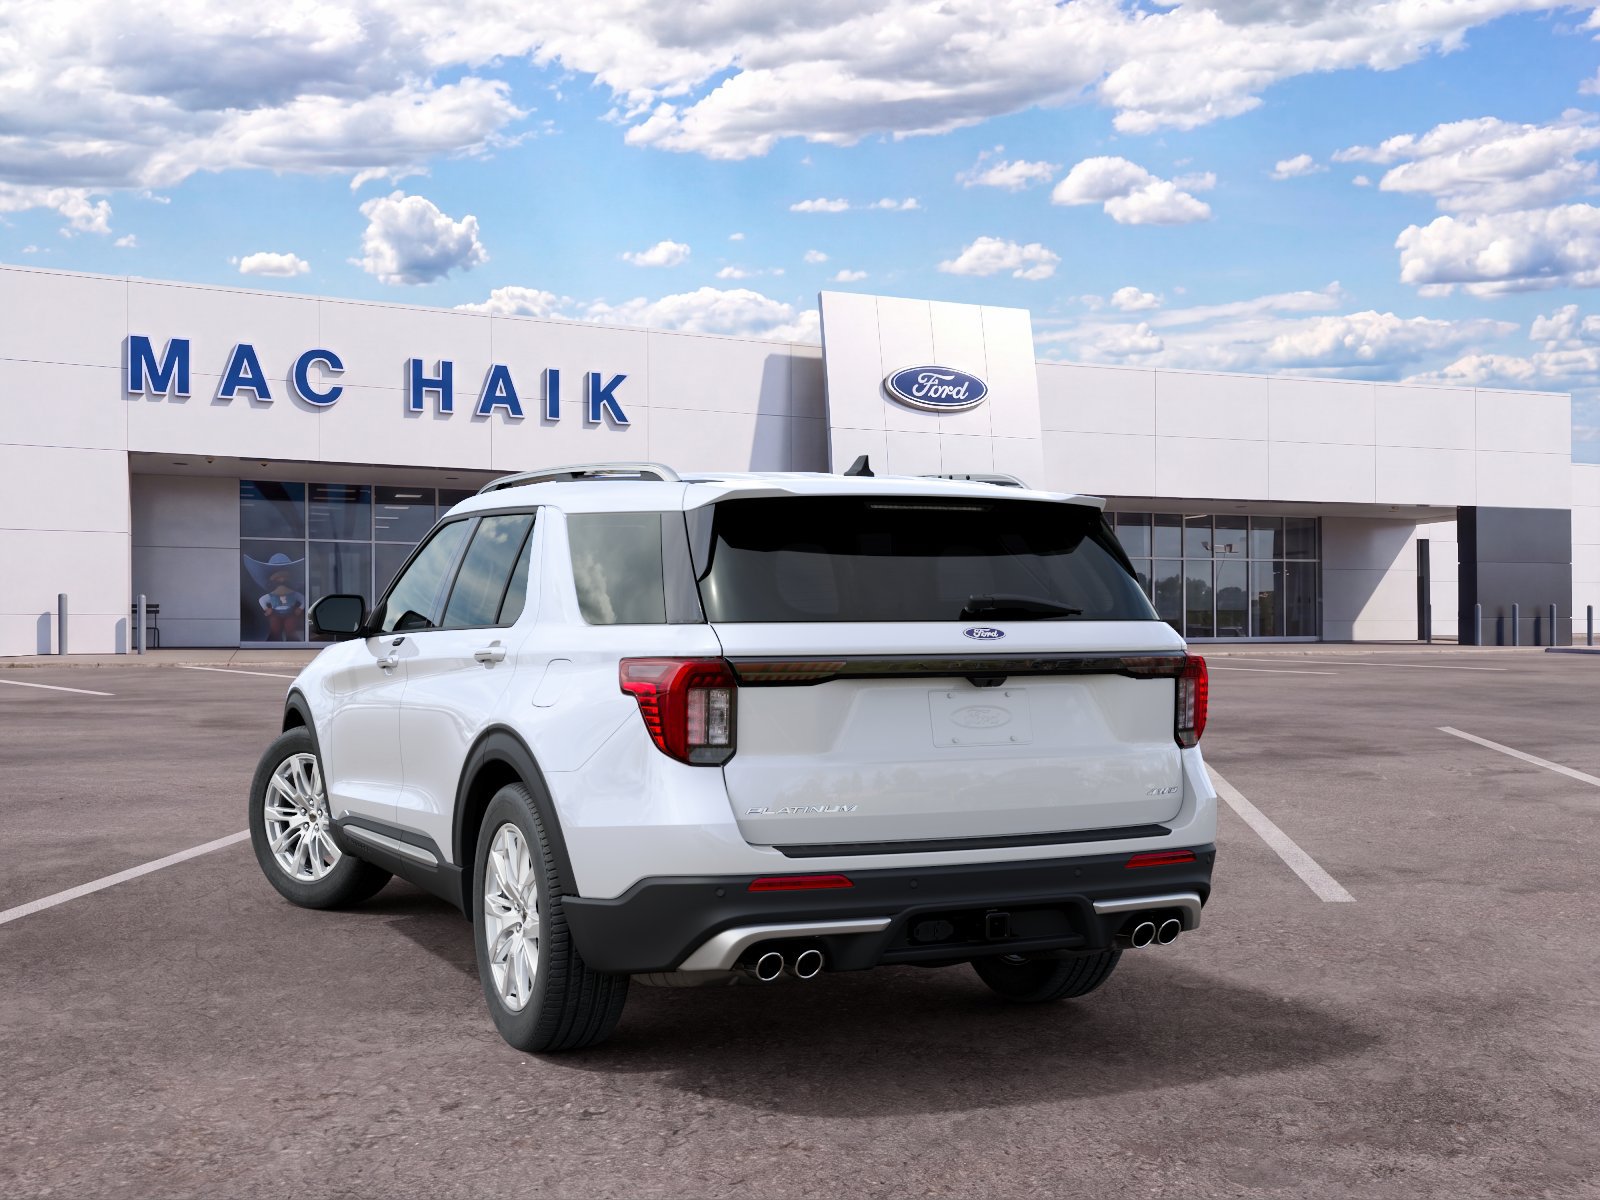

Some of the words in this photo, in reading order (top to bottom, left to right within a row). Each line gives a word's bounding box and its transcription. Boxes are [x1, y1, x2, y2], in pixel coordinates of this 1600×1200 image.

[126, 333, 346, 407] MAC
[407, 356, 631, 426] HAIK
[912, 372, 969, 399] Ford
[973, 628, 999, 637] Ford
[744, 804, 859, 815] PLATINUM
